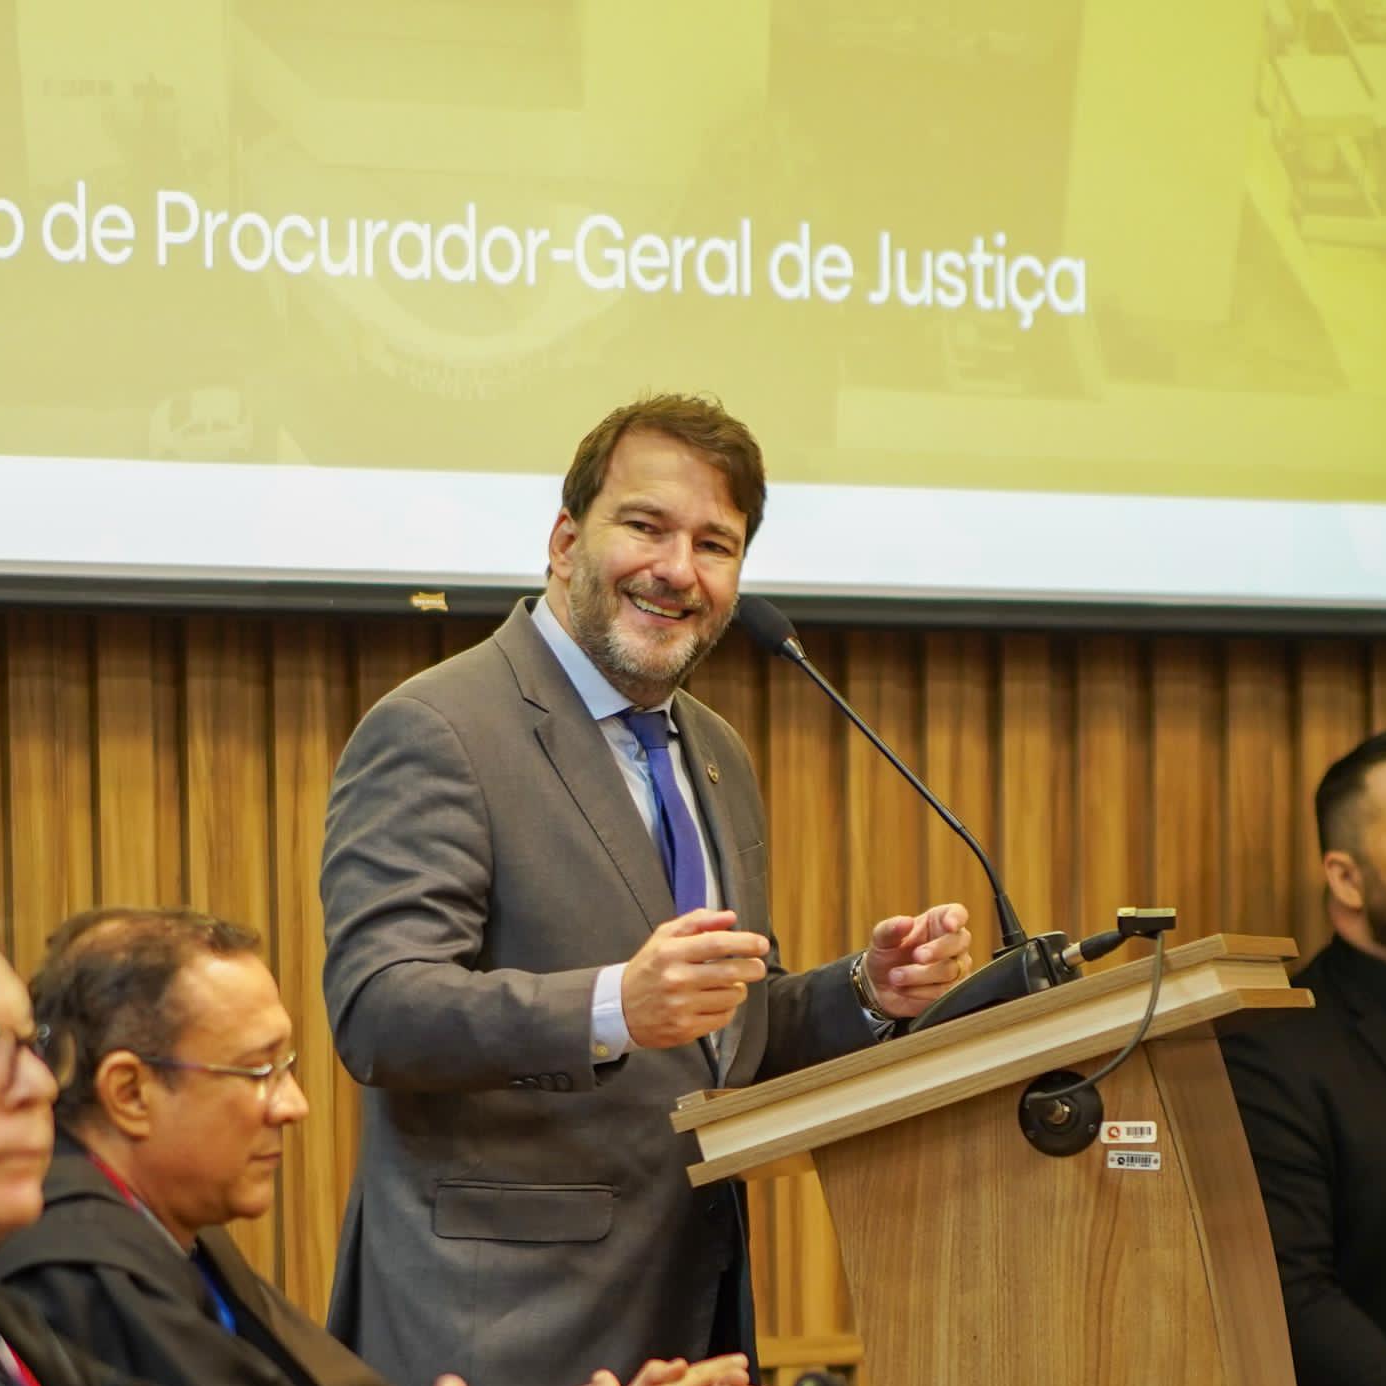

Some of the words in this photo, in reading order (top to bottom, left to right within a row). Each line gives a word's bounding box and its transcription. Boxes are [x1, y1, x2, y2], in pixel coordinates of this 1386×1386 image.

[41, 179, 136, 265] de
[156, 189, 752, 297] Procurador-Geral
[768, 221, 854, 302] de
[867, 230, 1086, 330] Justiça
